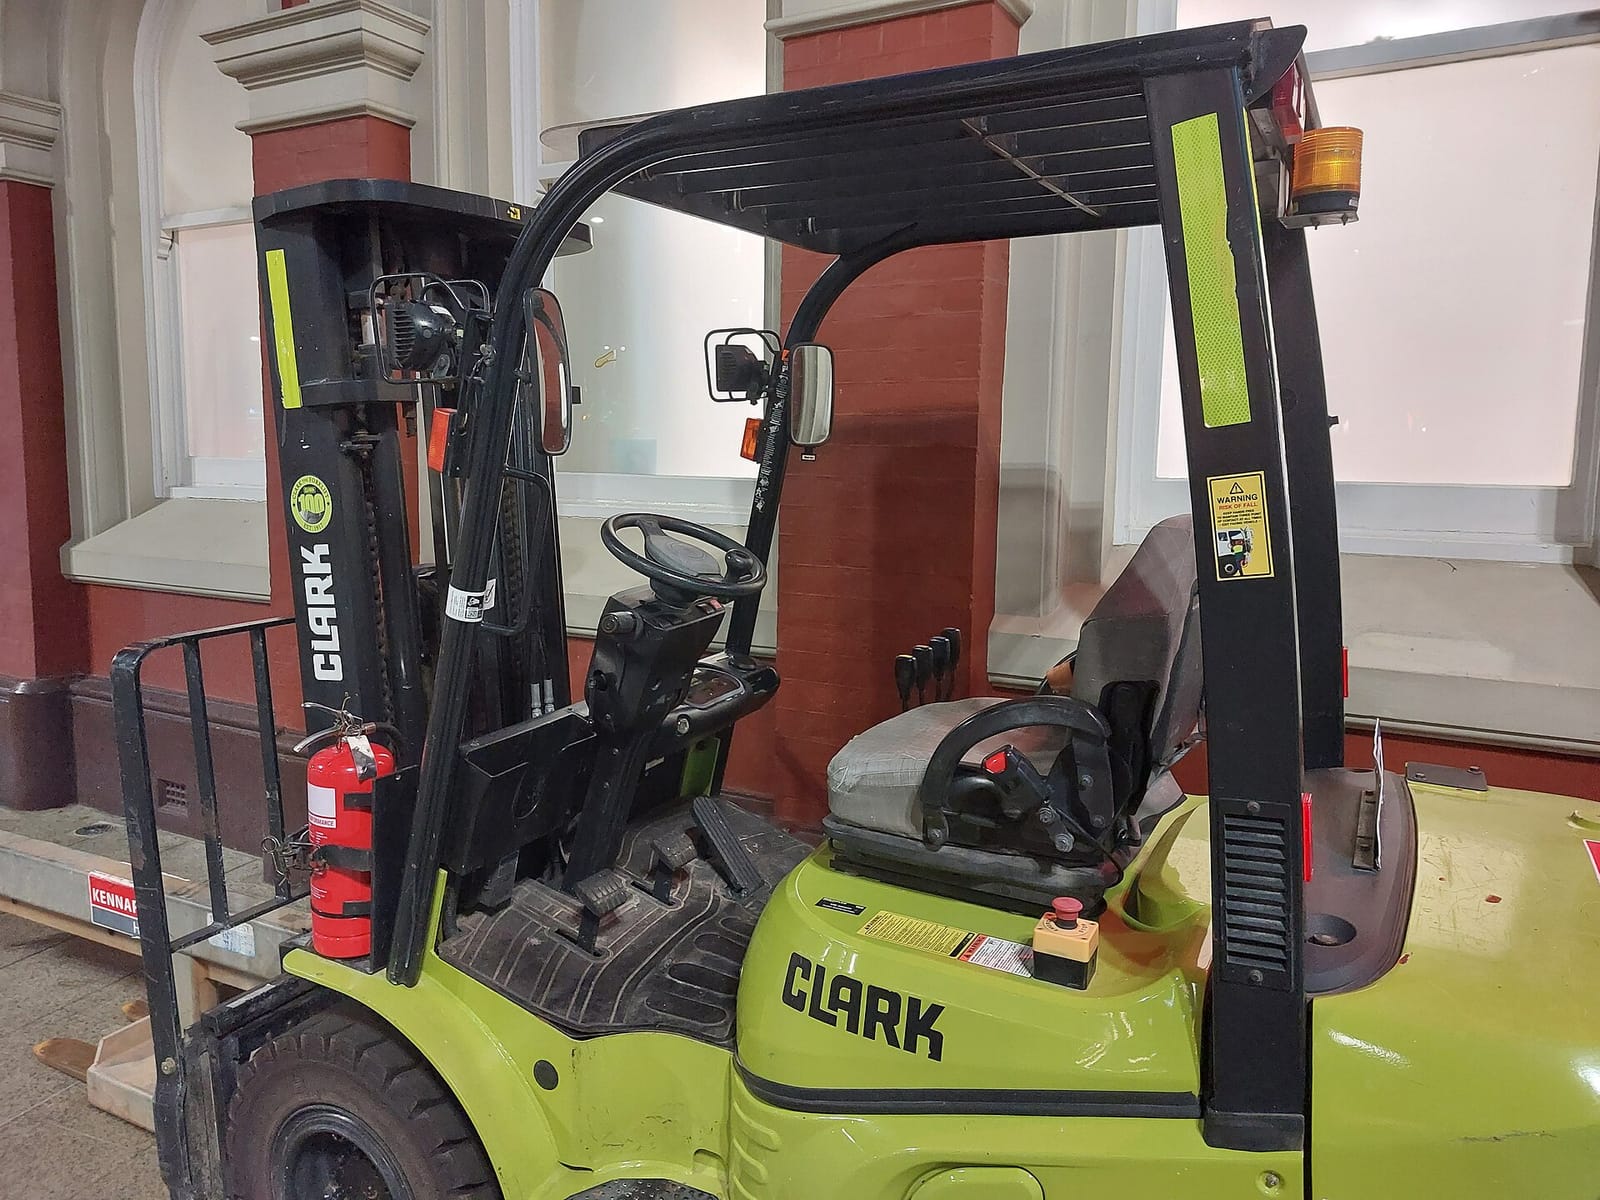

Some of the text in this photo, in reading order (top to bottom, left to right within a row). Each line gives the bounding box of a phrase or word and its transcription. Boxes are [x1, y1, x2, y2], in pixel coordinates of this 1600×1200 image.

[298, 493, 325, 514] 100
[1217, 493, 1258, 504] WARNING
[300, 544, 343, 681] CLARK
[782, 951, 946, 1062] CLARK
